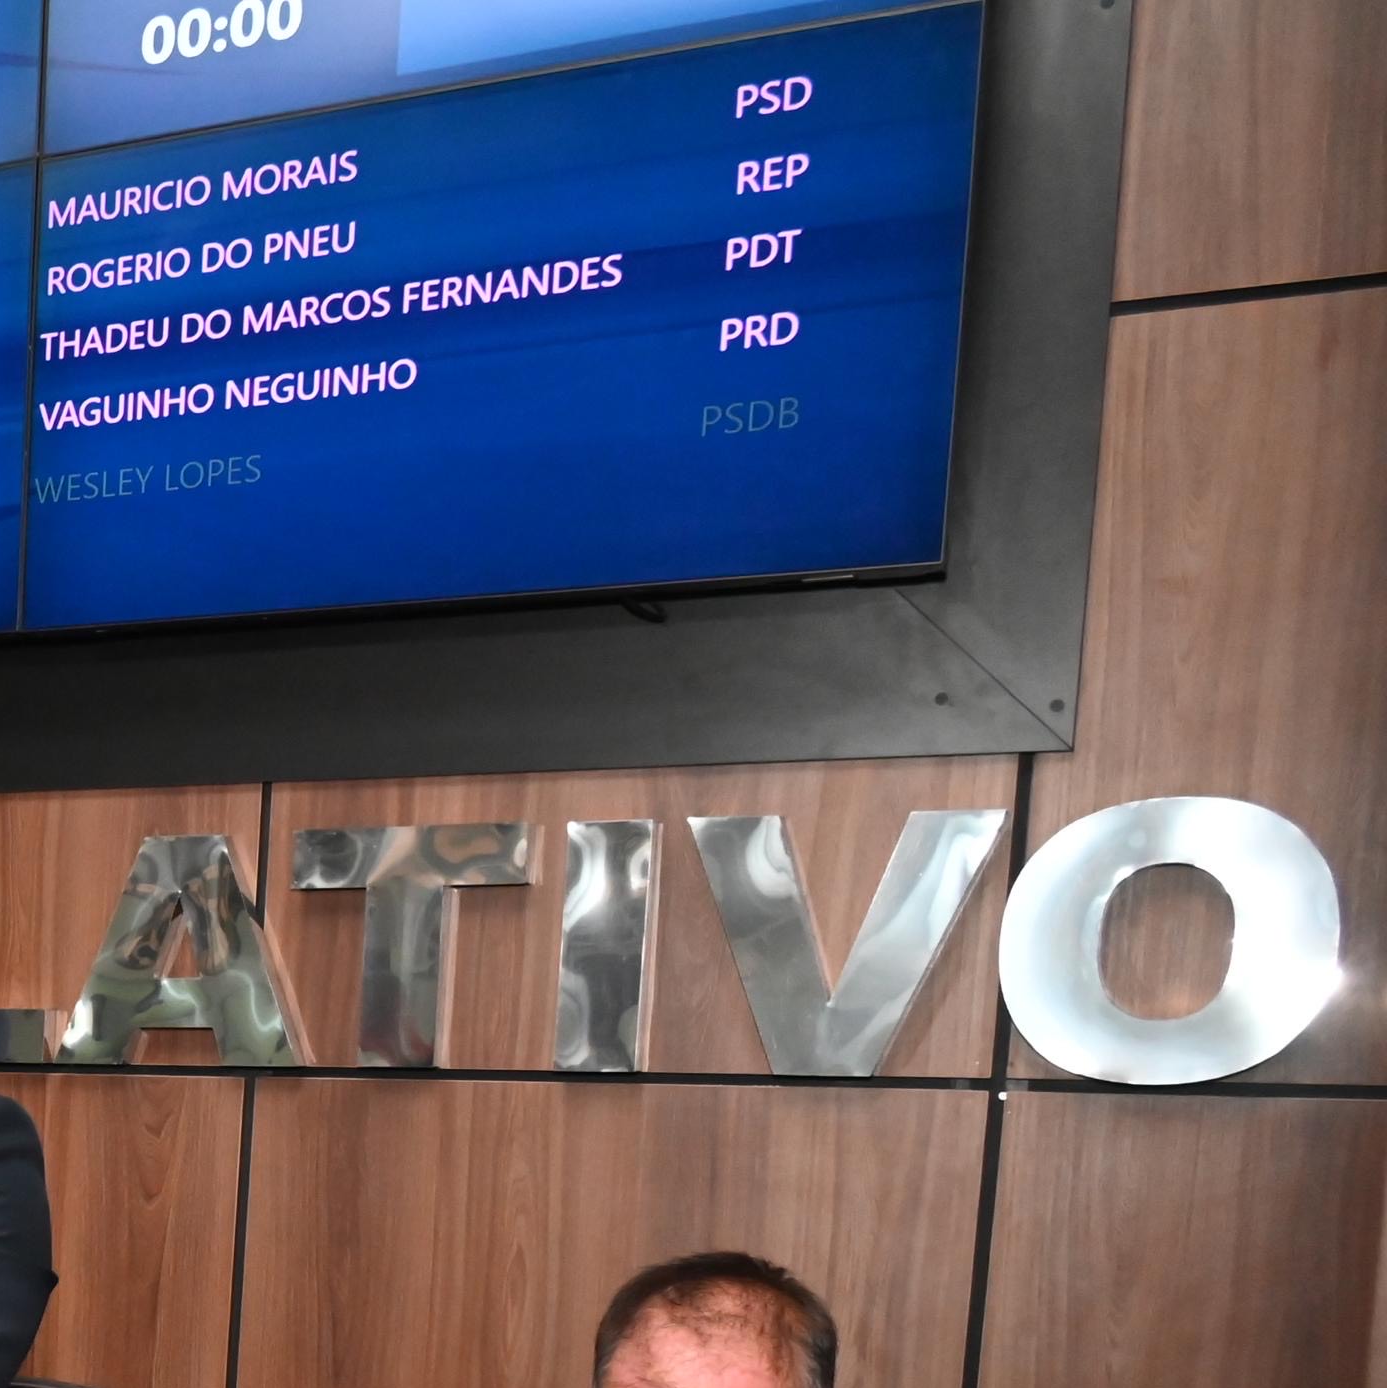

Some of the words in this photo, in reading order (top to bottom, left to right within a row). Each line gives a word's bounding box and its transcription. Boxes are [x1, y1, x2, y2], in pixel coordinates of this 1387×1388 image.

[141, 0, 303, 67] 00:00
[735, 75, 814, 120] PSD
[47, 174, 212, 230] MAURICIO
[223, 149, 359, 198] MORAIS
[736, 153, 810, 196] REP
[47, 246, 191, 298] ROGERIO
[201, 239, 253, 275] DO
[262, 222, 357, 265] PNEU
[724, 229, 802, 273] PDT
[40, 316, 171, 363] THADEU
[180, 308, 231, 345] DO
[241, 288, 392, 338] MARCOS
[402, 254, 623, 317] FERNANDES
[719, 311, 800, 353] PRD
[40, 380, 215, 434] VAGUINHO
[225, 358, 418, 410] NEGUINHO
[700, 396, 800, 439] PSDB
[35, 465, 154, 507] WESLEY
[164, 455, 262, 493] LOPES
